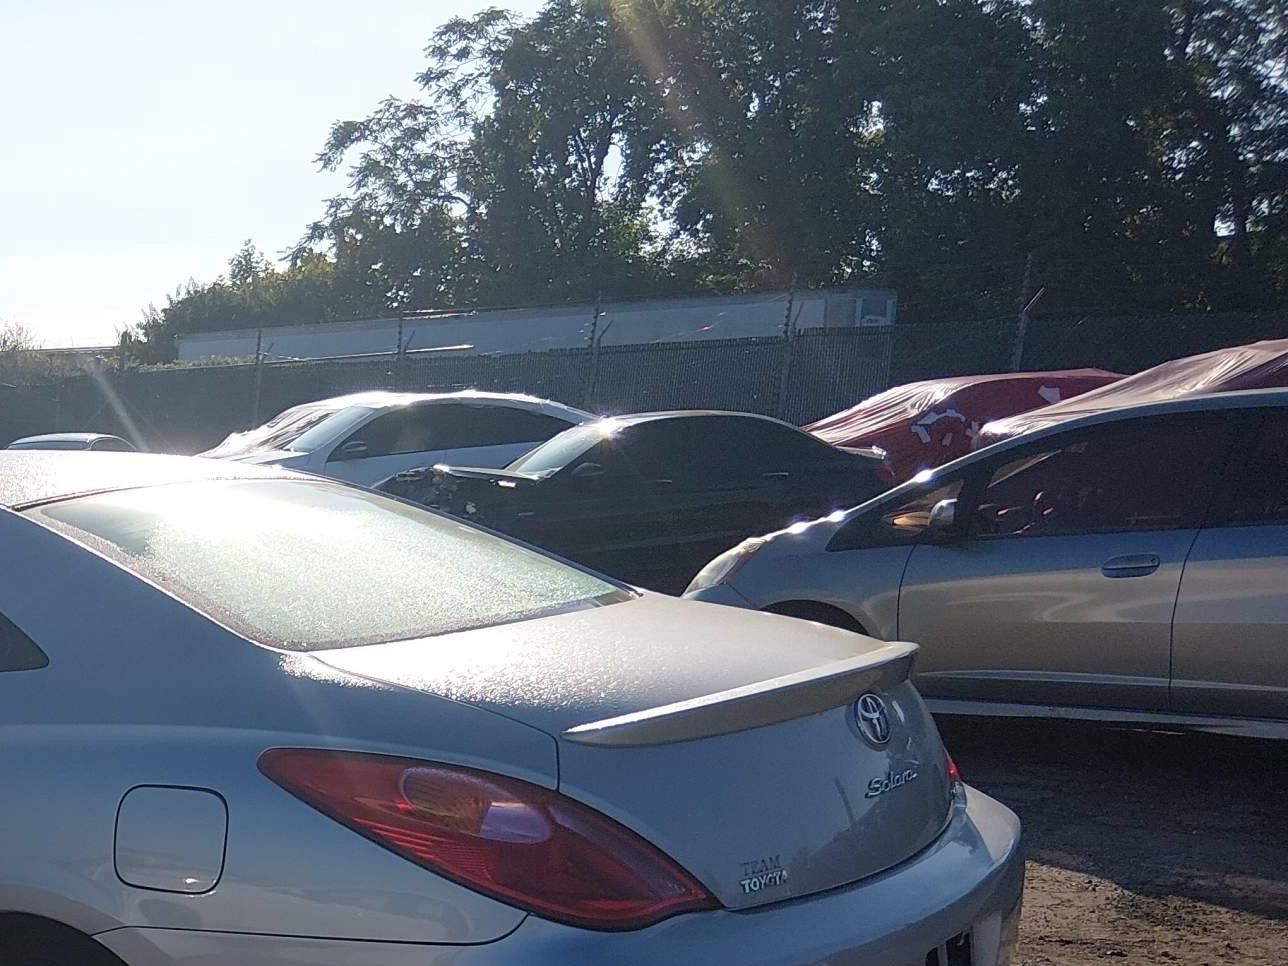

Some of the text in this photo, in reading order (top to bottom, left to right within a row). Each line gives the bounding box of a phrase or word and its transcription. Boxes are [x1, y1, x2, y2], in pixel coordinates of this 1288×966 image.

[865, 768, 918, 798] Solara
[740, 854, 782, 876] TEAM
[740, 870, 788, 893] TOYOTA
